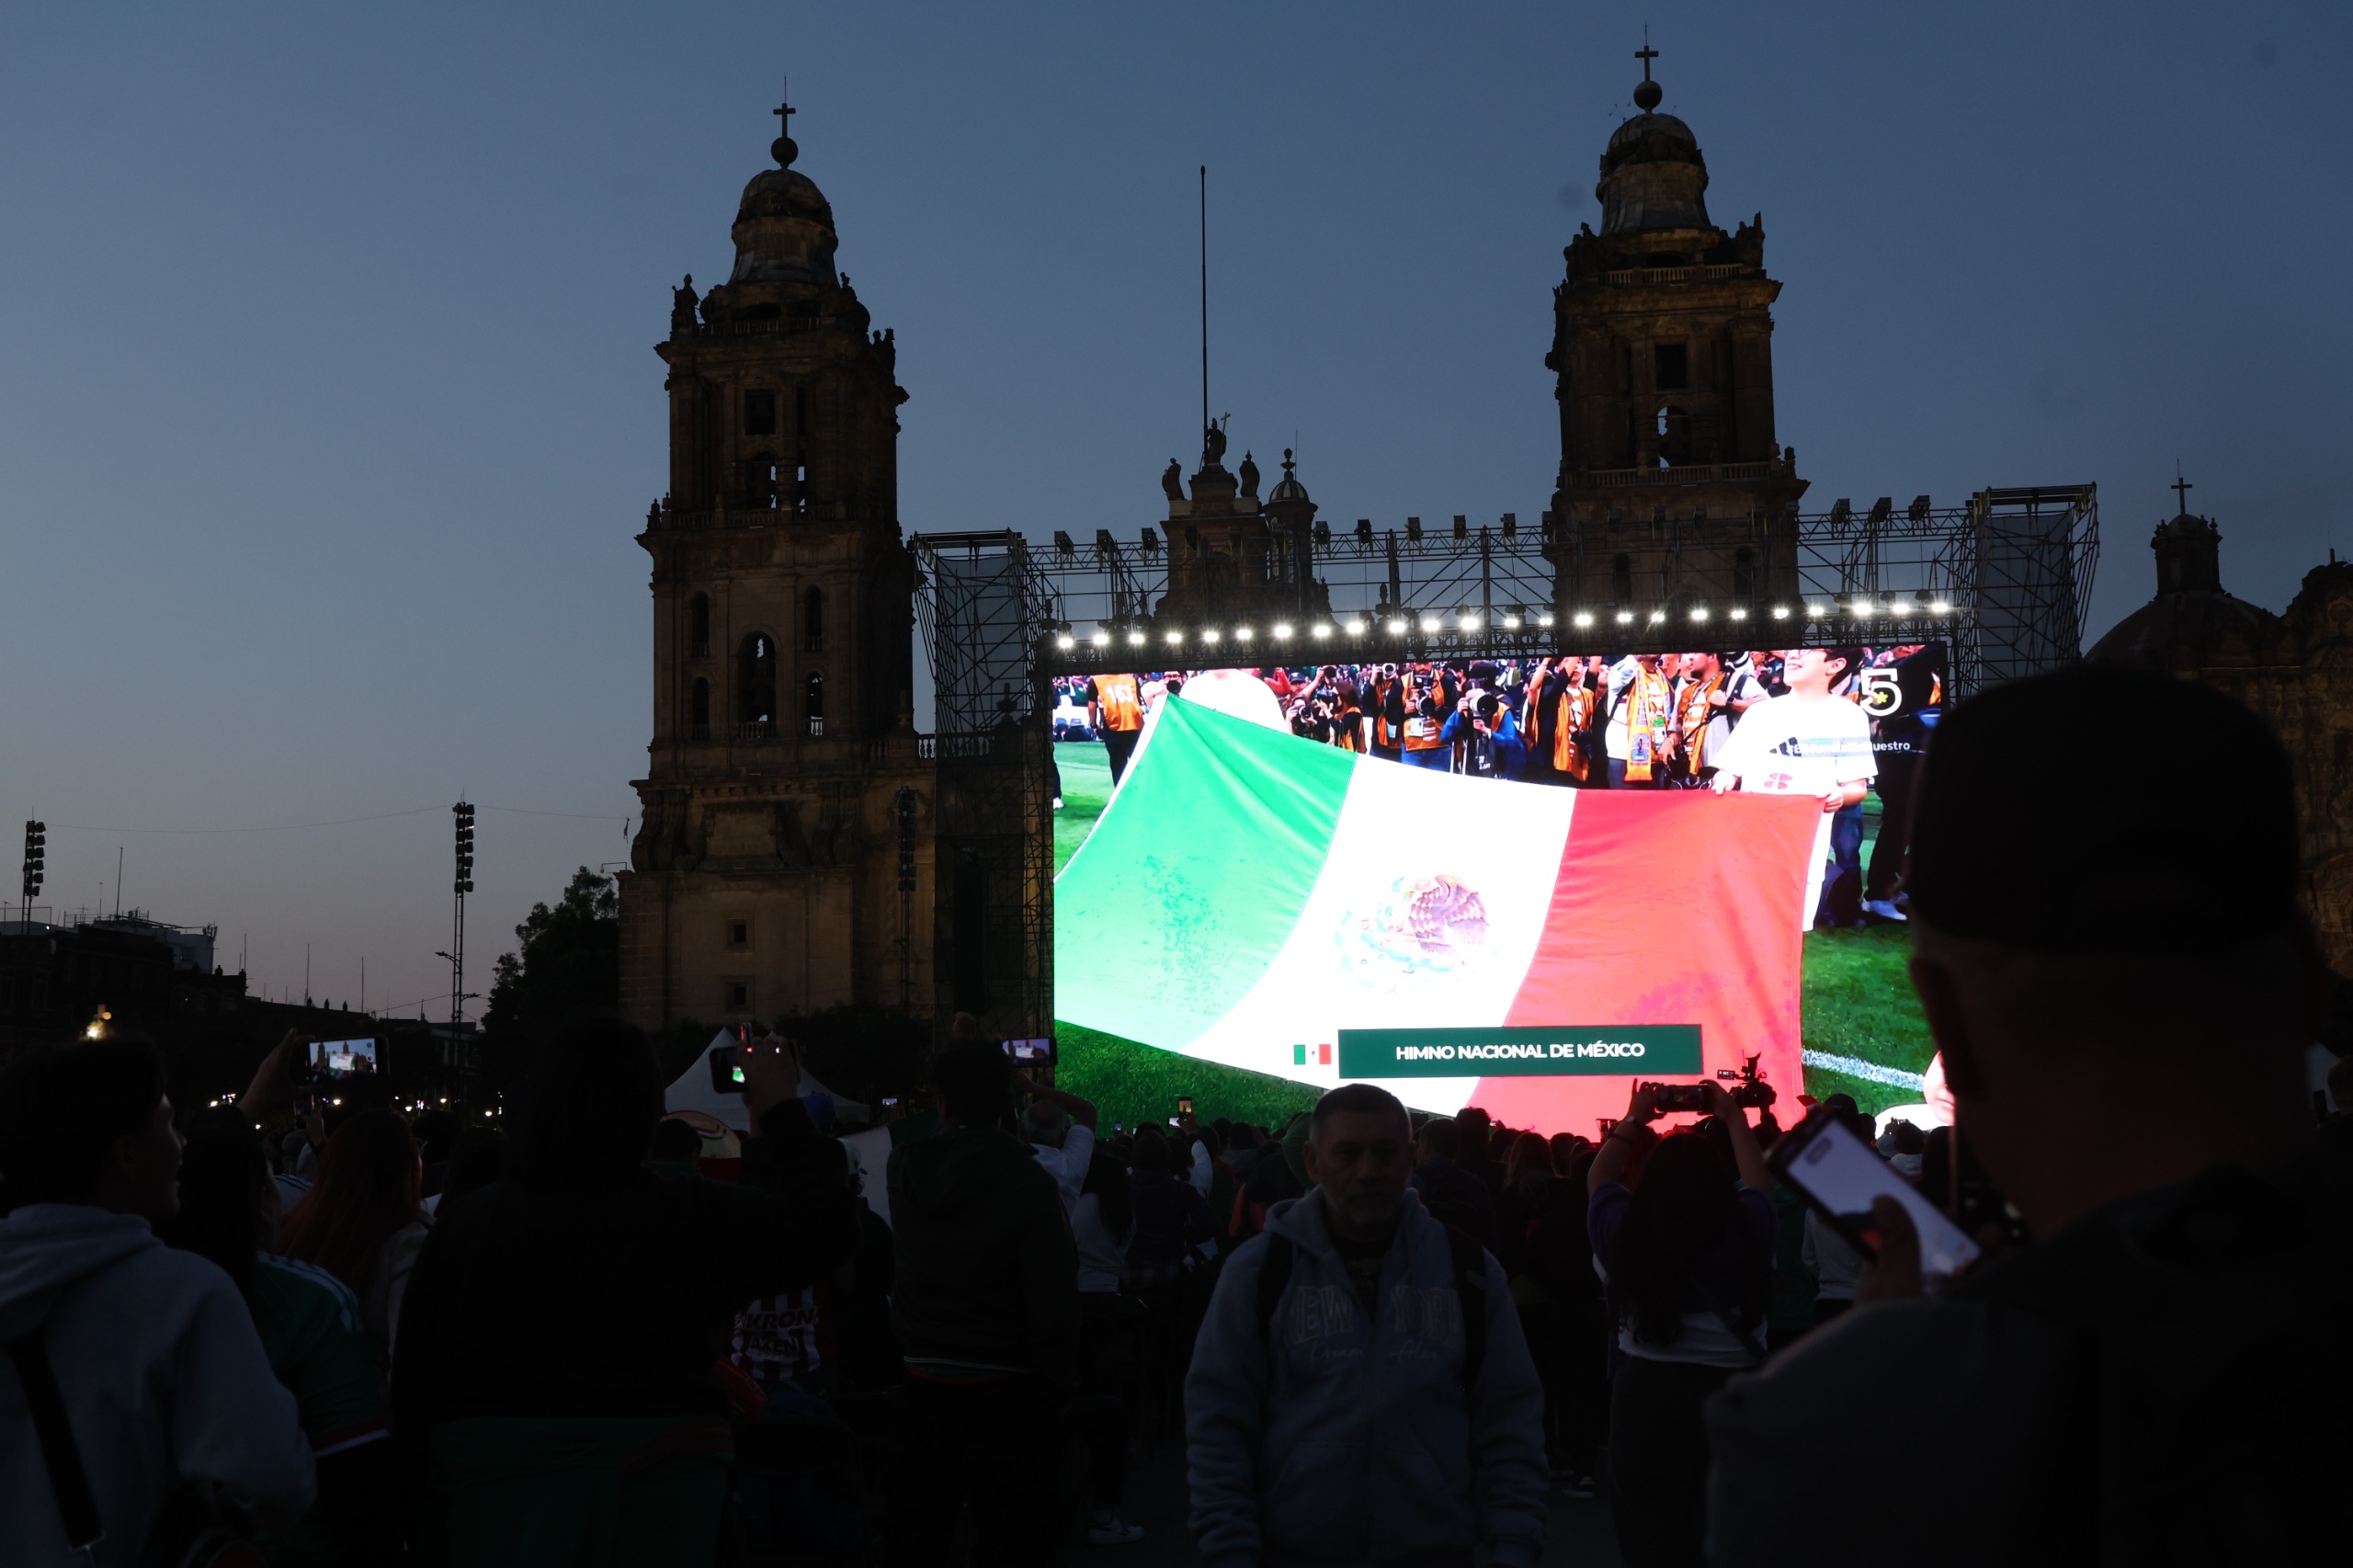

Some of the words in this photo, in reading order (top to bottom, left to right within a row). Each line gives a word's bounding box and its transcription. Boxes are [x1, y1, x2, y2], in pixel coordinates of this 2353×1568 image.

[1106, 684, 1134, 704] 163
[1860, 668, 1902, 716] 5
[1396, 1045, 1455, 1060] HIMNO
[1458, 1044, 1547, 1059] NACIONAL
[1550, 1043, 1574, 1058] DE
[1577, 1040, 1645, 1057] MÉXICO
[1284, 1285, 1353, 1347] NEW
